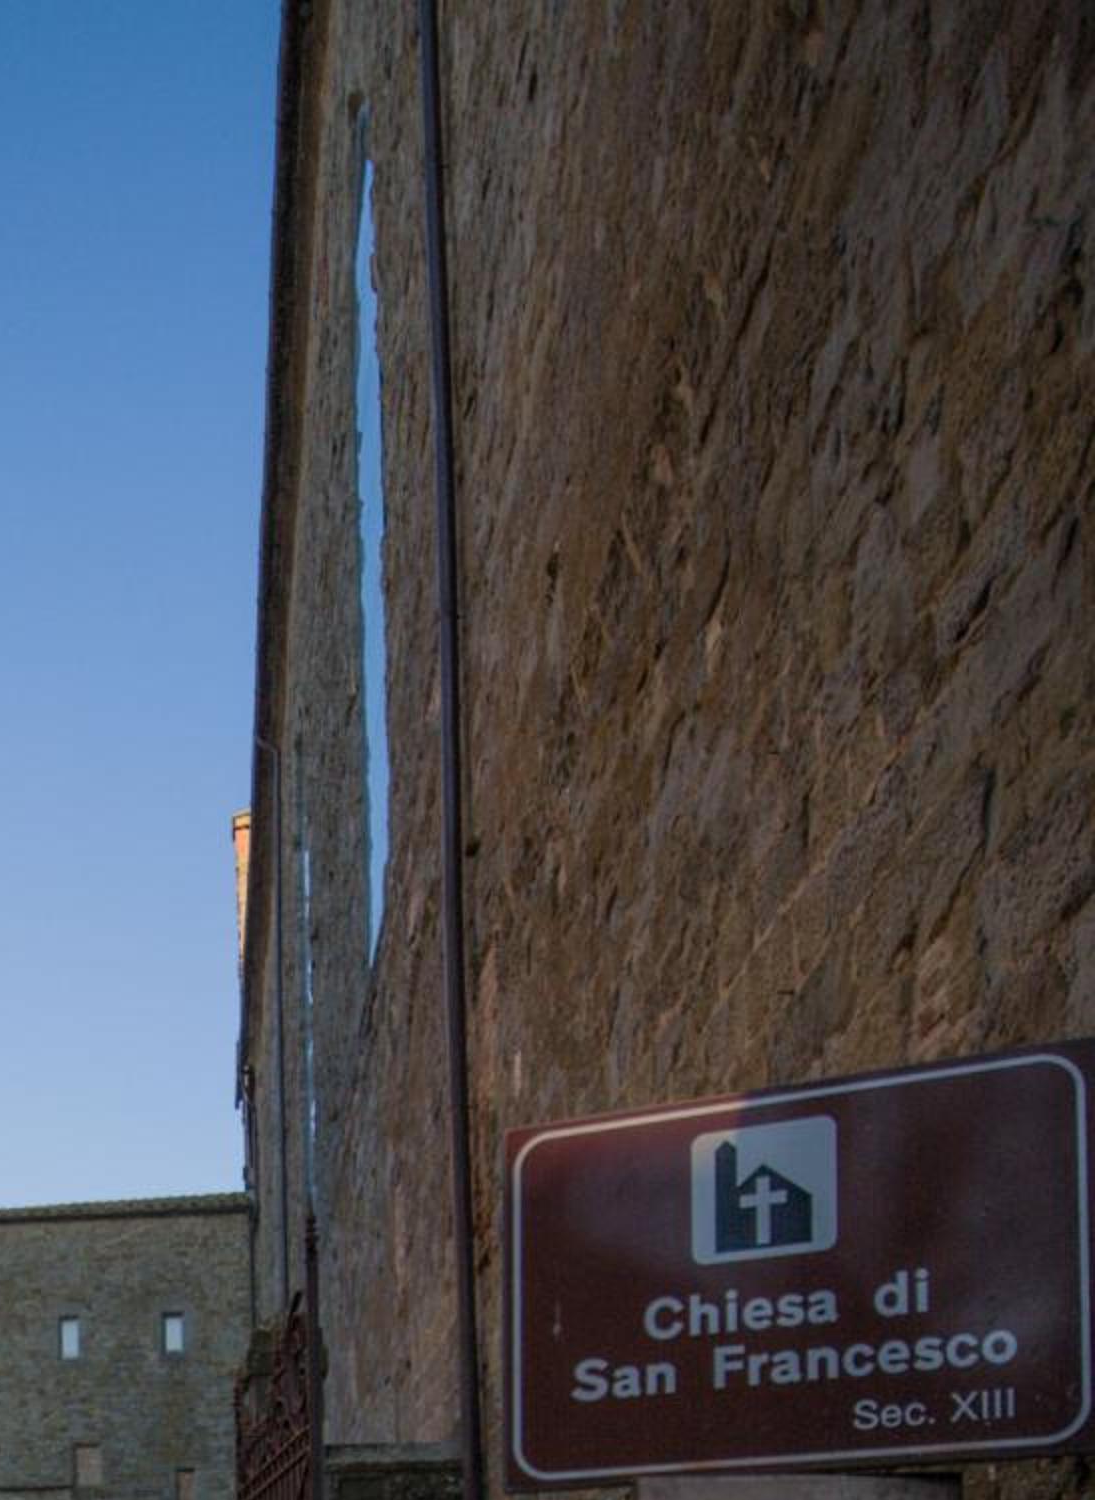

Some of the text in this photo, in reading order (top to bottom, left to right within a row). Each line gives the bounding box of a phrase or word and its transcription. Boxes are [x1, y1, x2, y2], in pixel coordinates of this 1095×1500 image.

[644, 1269, 930, 1340] Chiesa di
[571, 1329, 1018, 1401] San Francesco
[853, 1388, 1016, 1431] Sec. XIII
